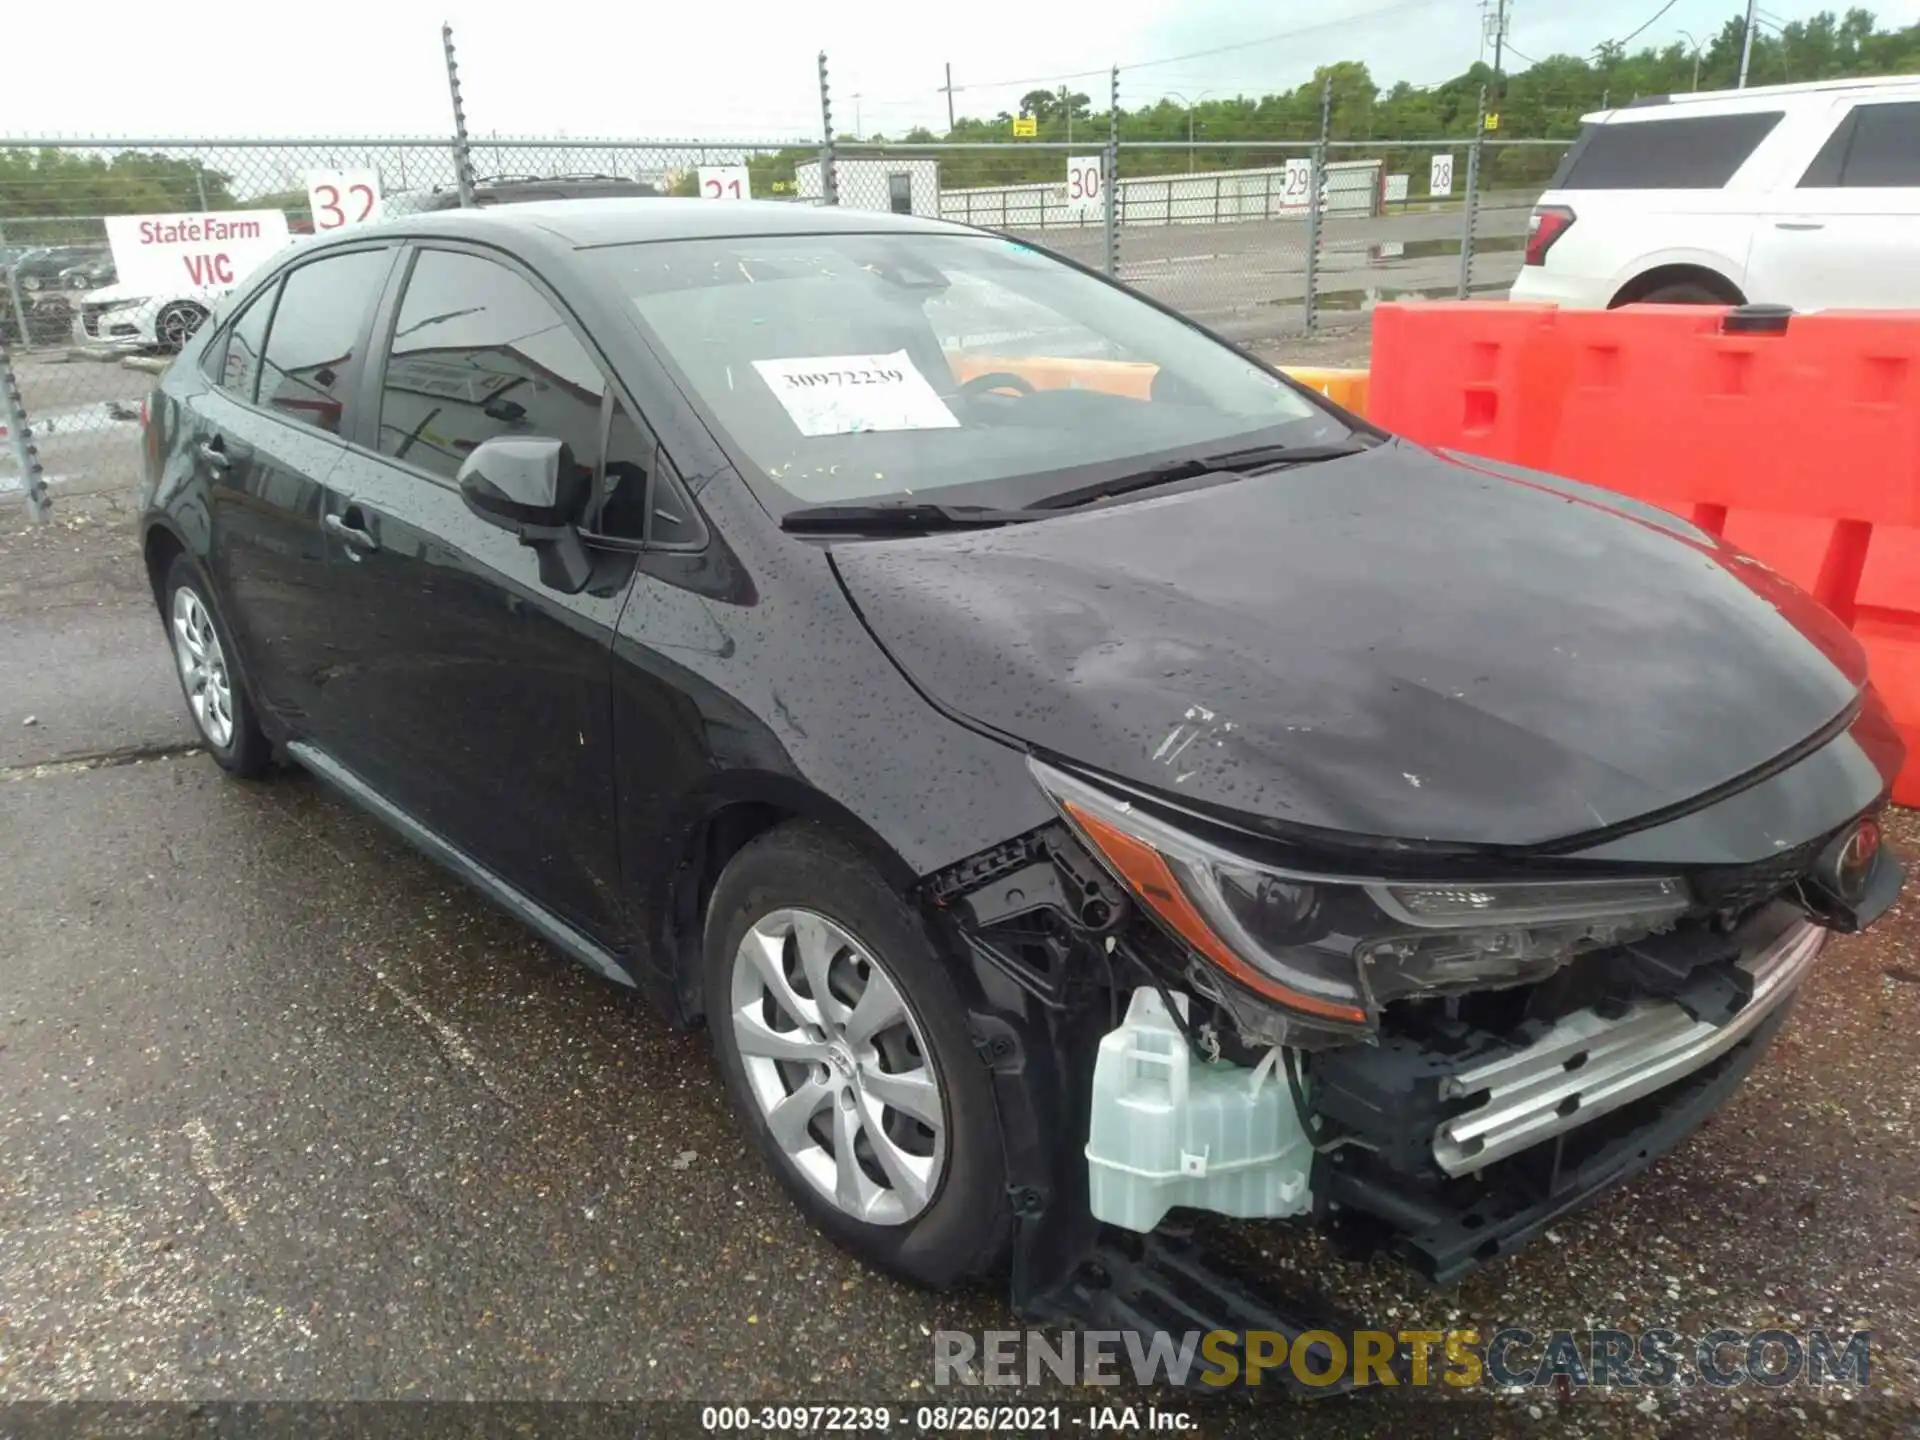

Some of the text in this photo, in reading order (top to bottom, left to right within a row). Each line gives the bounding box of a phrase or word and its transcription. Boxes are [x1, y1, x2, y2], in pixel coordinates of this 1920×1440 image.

[1070, 167, 1098, 199] 30
[1286, 168, 1309, 196] 29
[1431, 163, 1450, 187] 28
[314, 184, 374, 230] 32
[184, 253, 235, 287] VIC
[783, 370, 904, 388] 30972239
